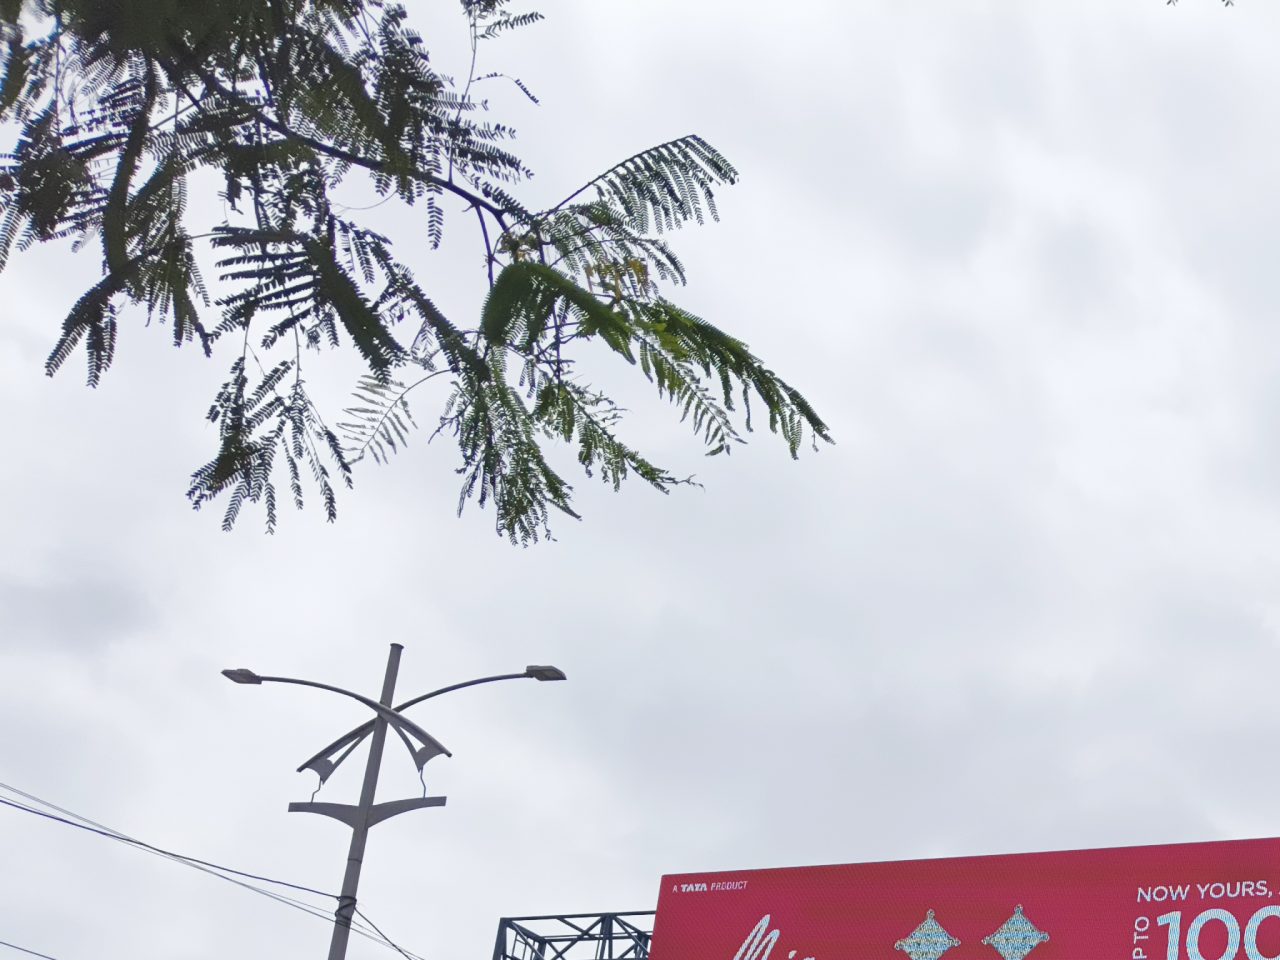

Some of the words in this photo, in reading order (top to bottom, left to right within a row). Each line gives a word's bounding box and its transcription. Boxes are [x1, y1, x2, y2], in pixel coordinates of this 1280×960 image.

[672, 884, 678, 893] A
[681, 882, 707, 892] TATA
[711, 880, 748, 891] PRODUCT
[1137, 884, 1190, 902] NOW
[1196, 880, 1273, 899] YOURS,
[1133, 916, 1150, 945] TO
